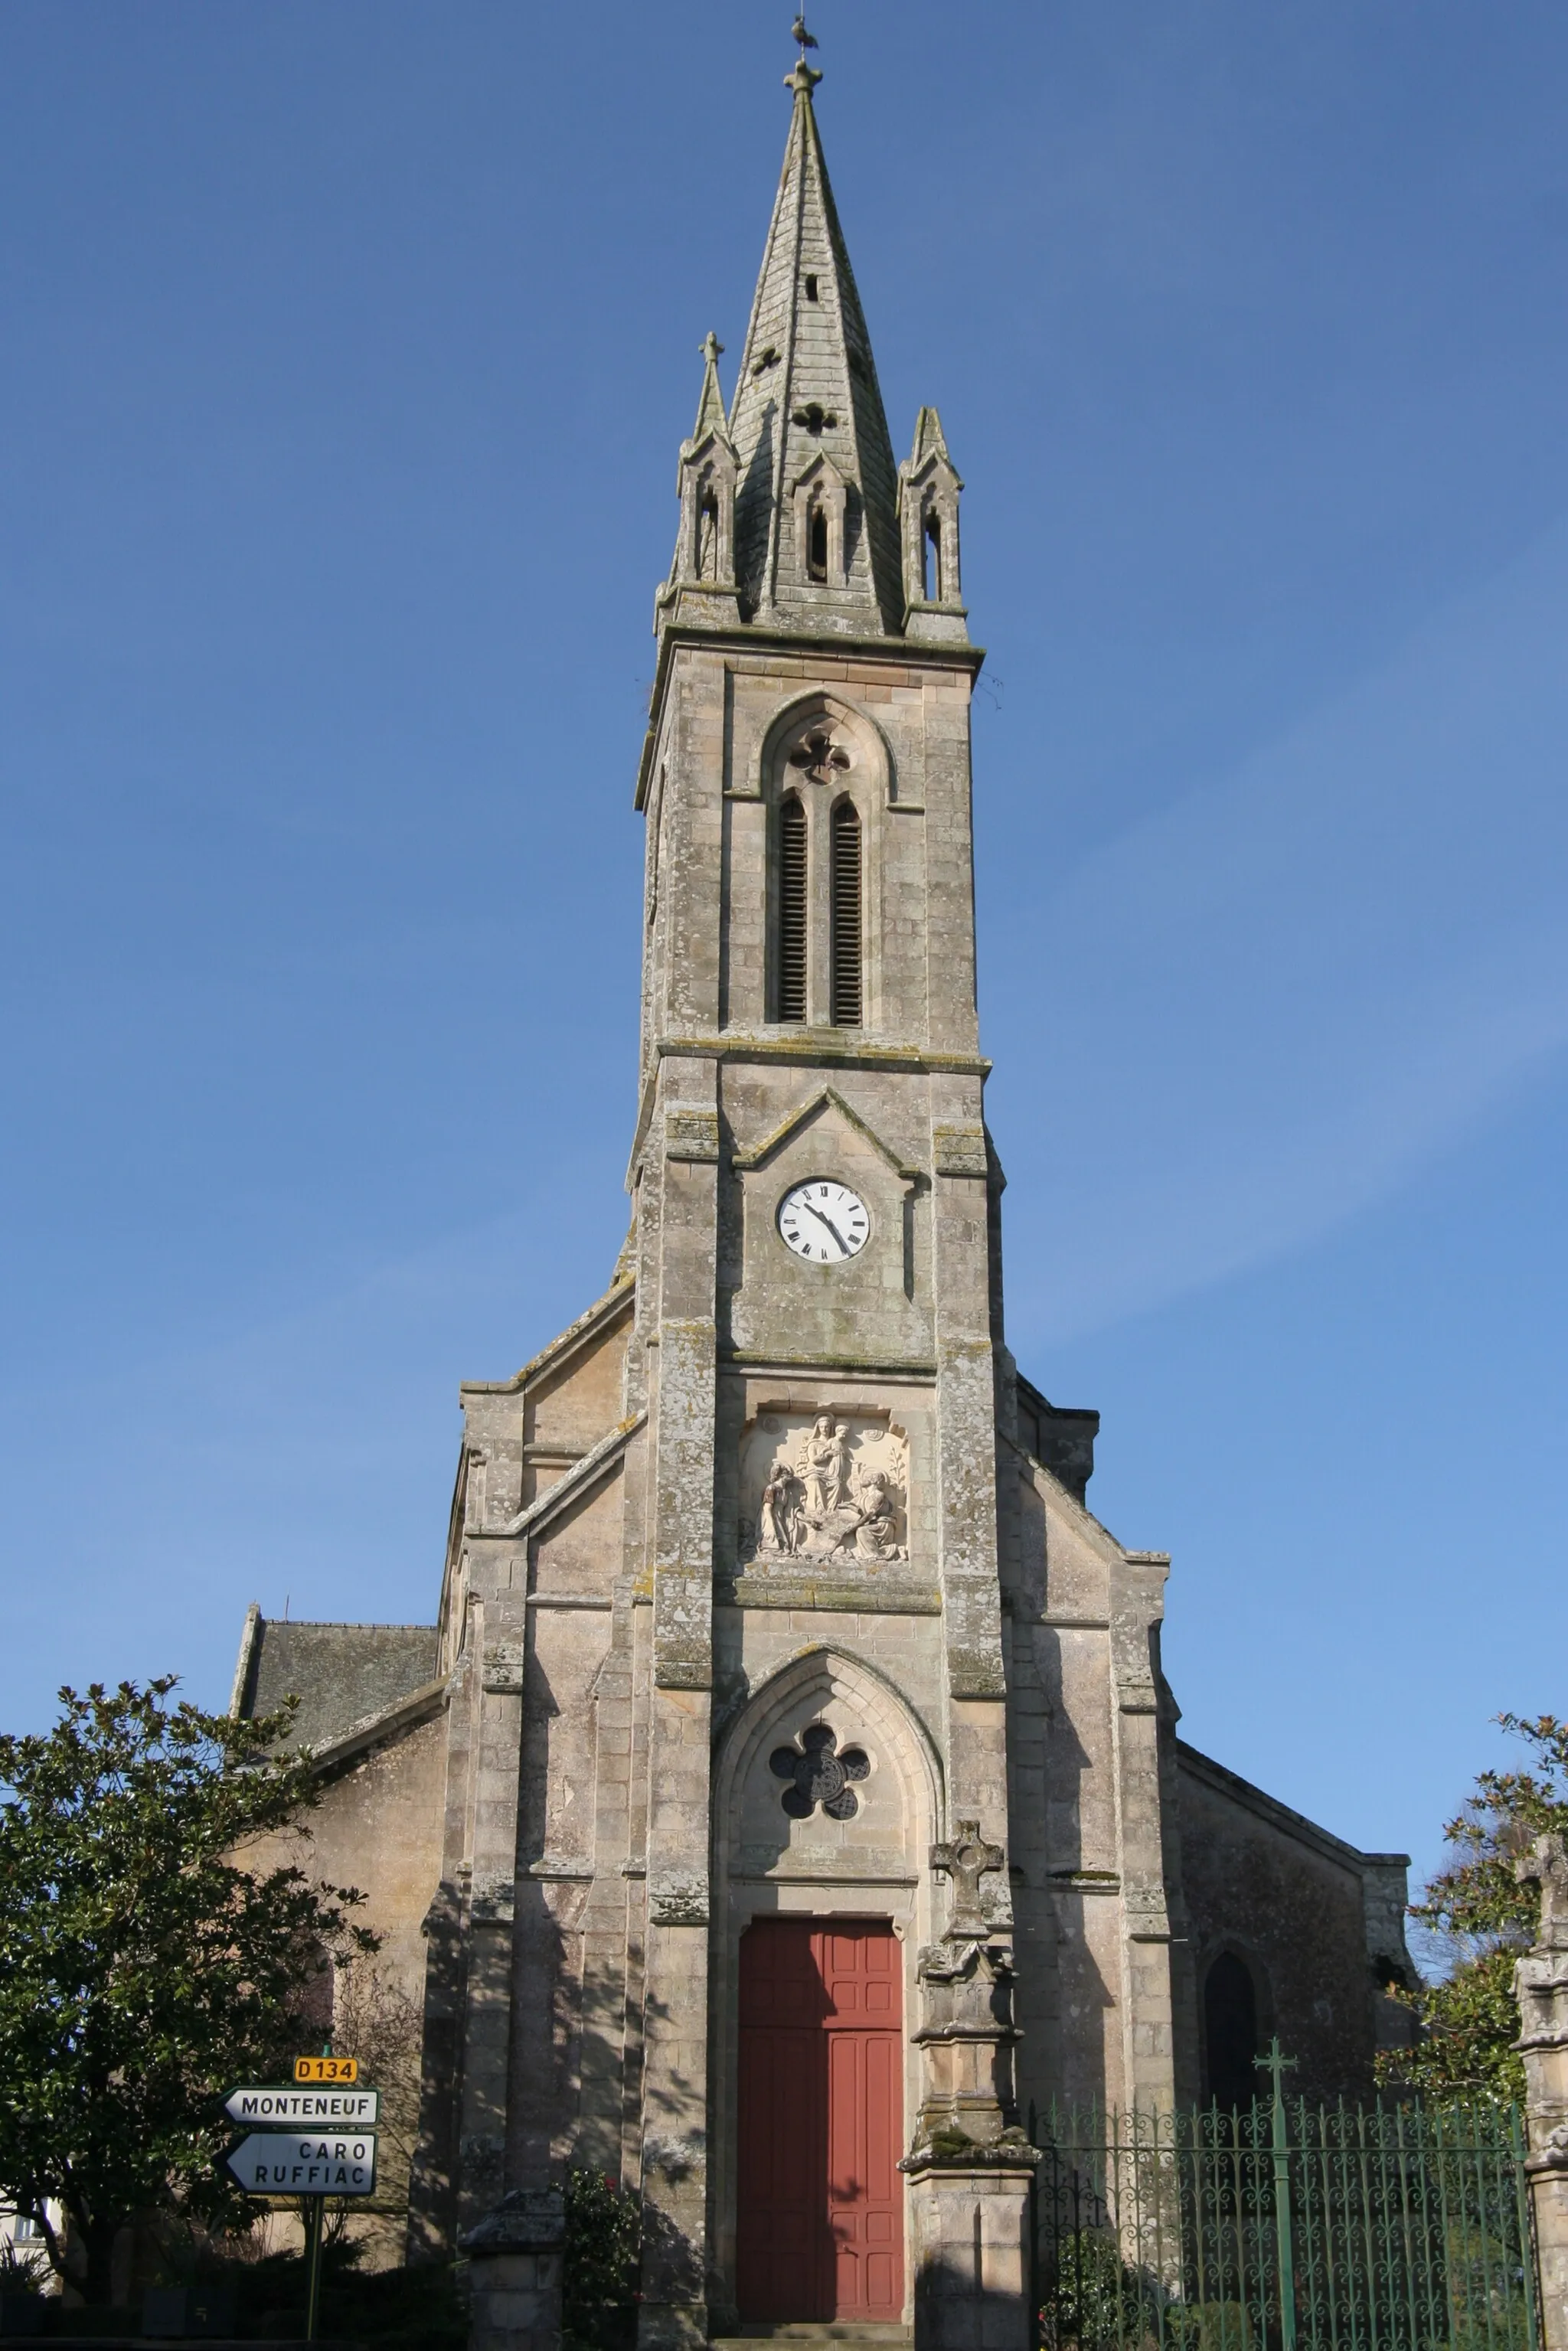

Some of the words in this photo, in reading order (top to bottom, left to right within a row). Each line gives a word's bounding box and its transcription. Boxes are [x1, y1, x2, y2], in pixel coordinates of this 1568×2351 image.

[242, 2098, 369, 2115] MONTENEUF
[299, 2142, 366, 2160] CARO
[256, 2166, 364, 2184] RUFFIAC
